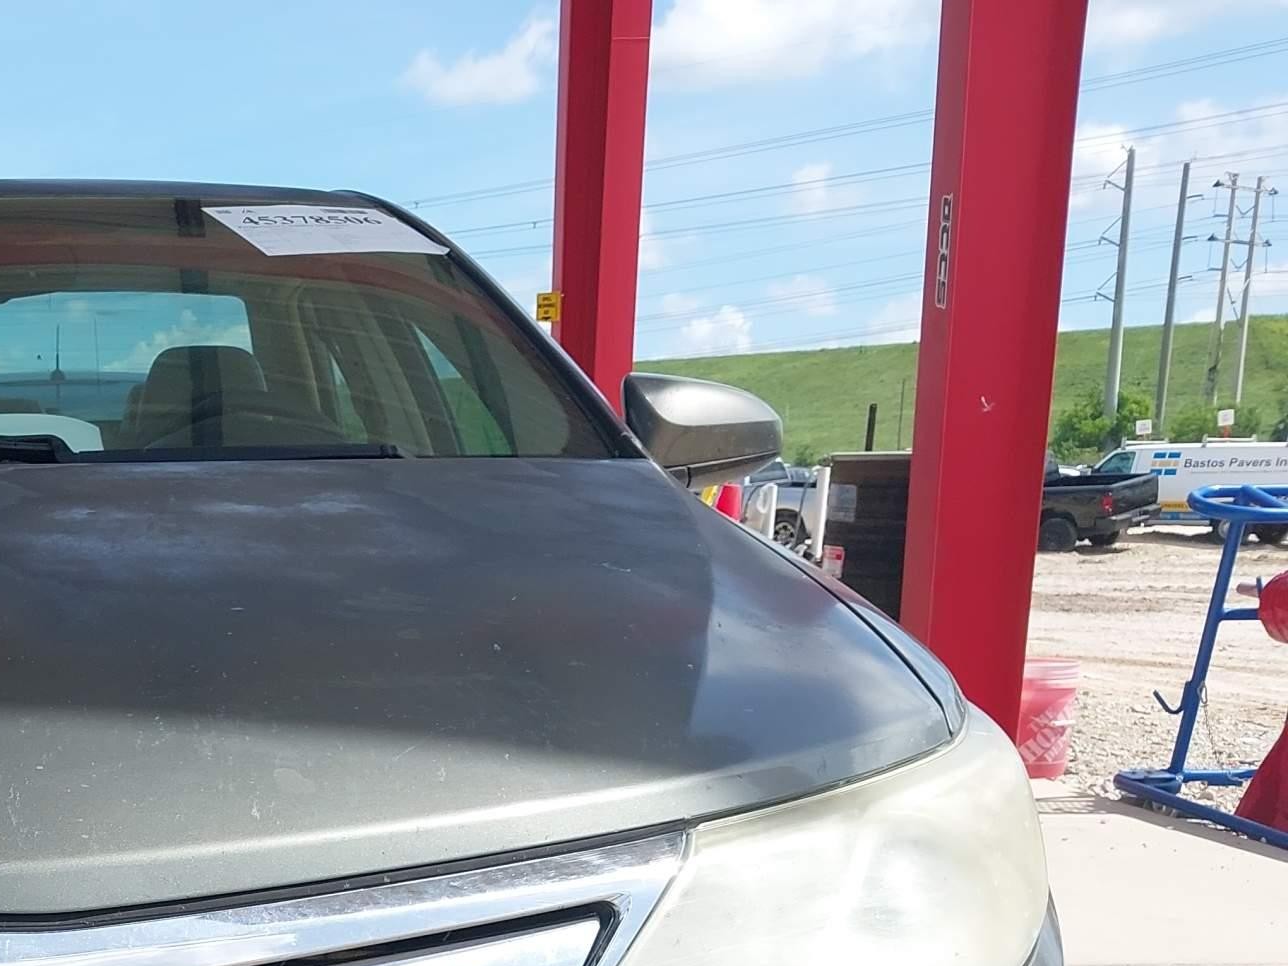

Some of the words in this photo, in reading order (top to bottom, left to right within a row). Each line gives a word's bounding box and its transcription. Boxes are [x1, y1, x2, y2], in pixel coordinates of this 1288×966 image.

[242, 215, 382, 226] 45378506
[1184, 458, 1225, 468] Bastos
[1229, 457, 1272, 467] Pavers
